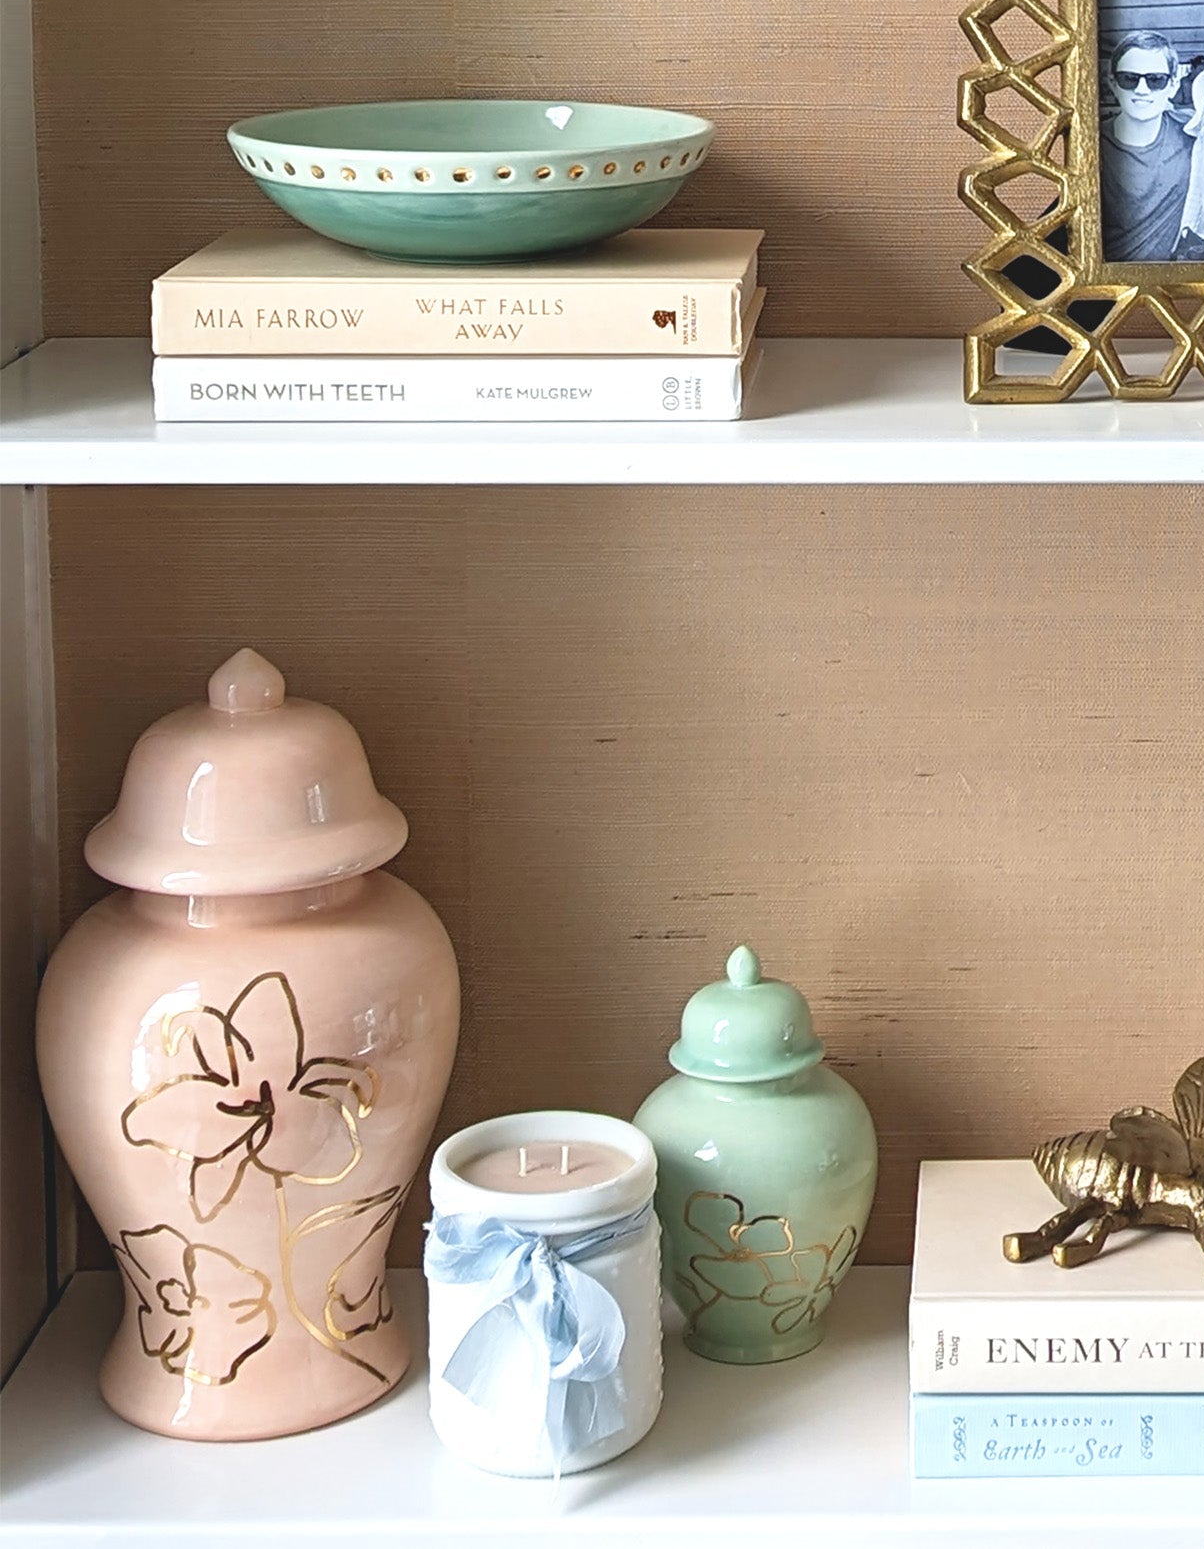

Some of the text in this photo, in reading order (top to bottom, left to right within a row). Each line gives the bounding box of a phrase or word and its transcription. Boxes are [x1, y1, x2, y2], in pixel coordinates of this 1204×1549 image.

[415, 298, 564, 316] WHAT FALLS
[194, 308, 364, 330] MIA FARROW
[455, 323, 524, 342] AWAY
[190, 383, 405, 402] BORN WITH TEETH
[476, 387, 593, 400] KATE MULGREW
[935, 1329, 945, 1372] William
[948, 1335, 961, 1367] Craig
[987, 1337, 1129, 1363] ENEMY
[1138, 1341, 1172, 1359] AT
[990, 1418, 999, 1428] A
[983, 1438, 1047, 1461] Earth
[1075, 1437, 1124, 1467] Sea
